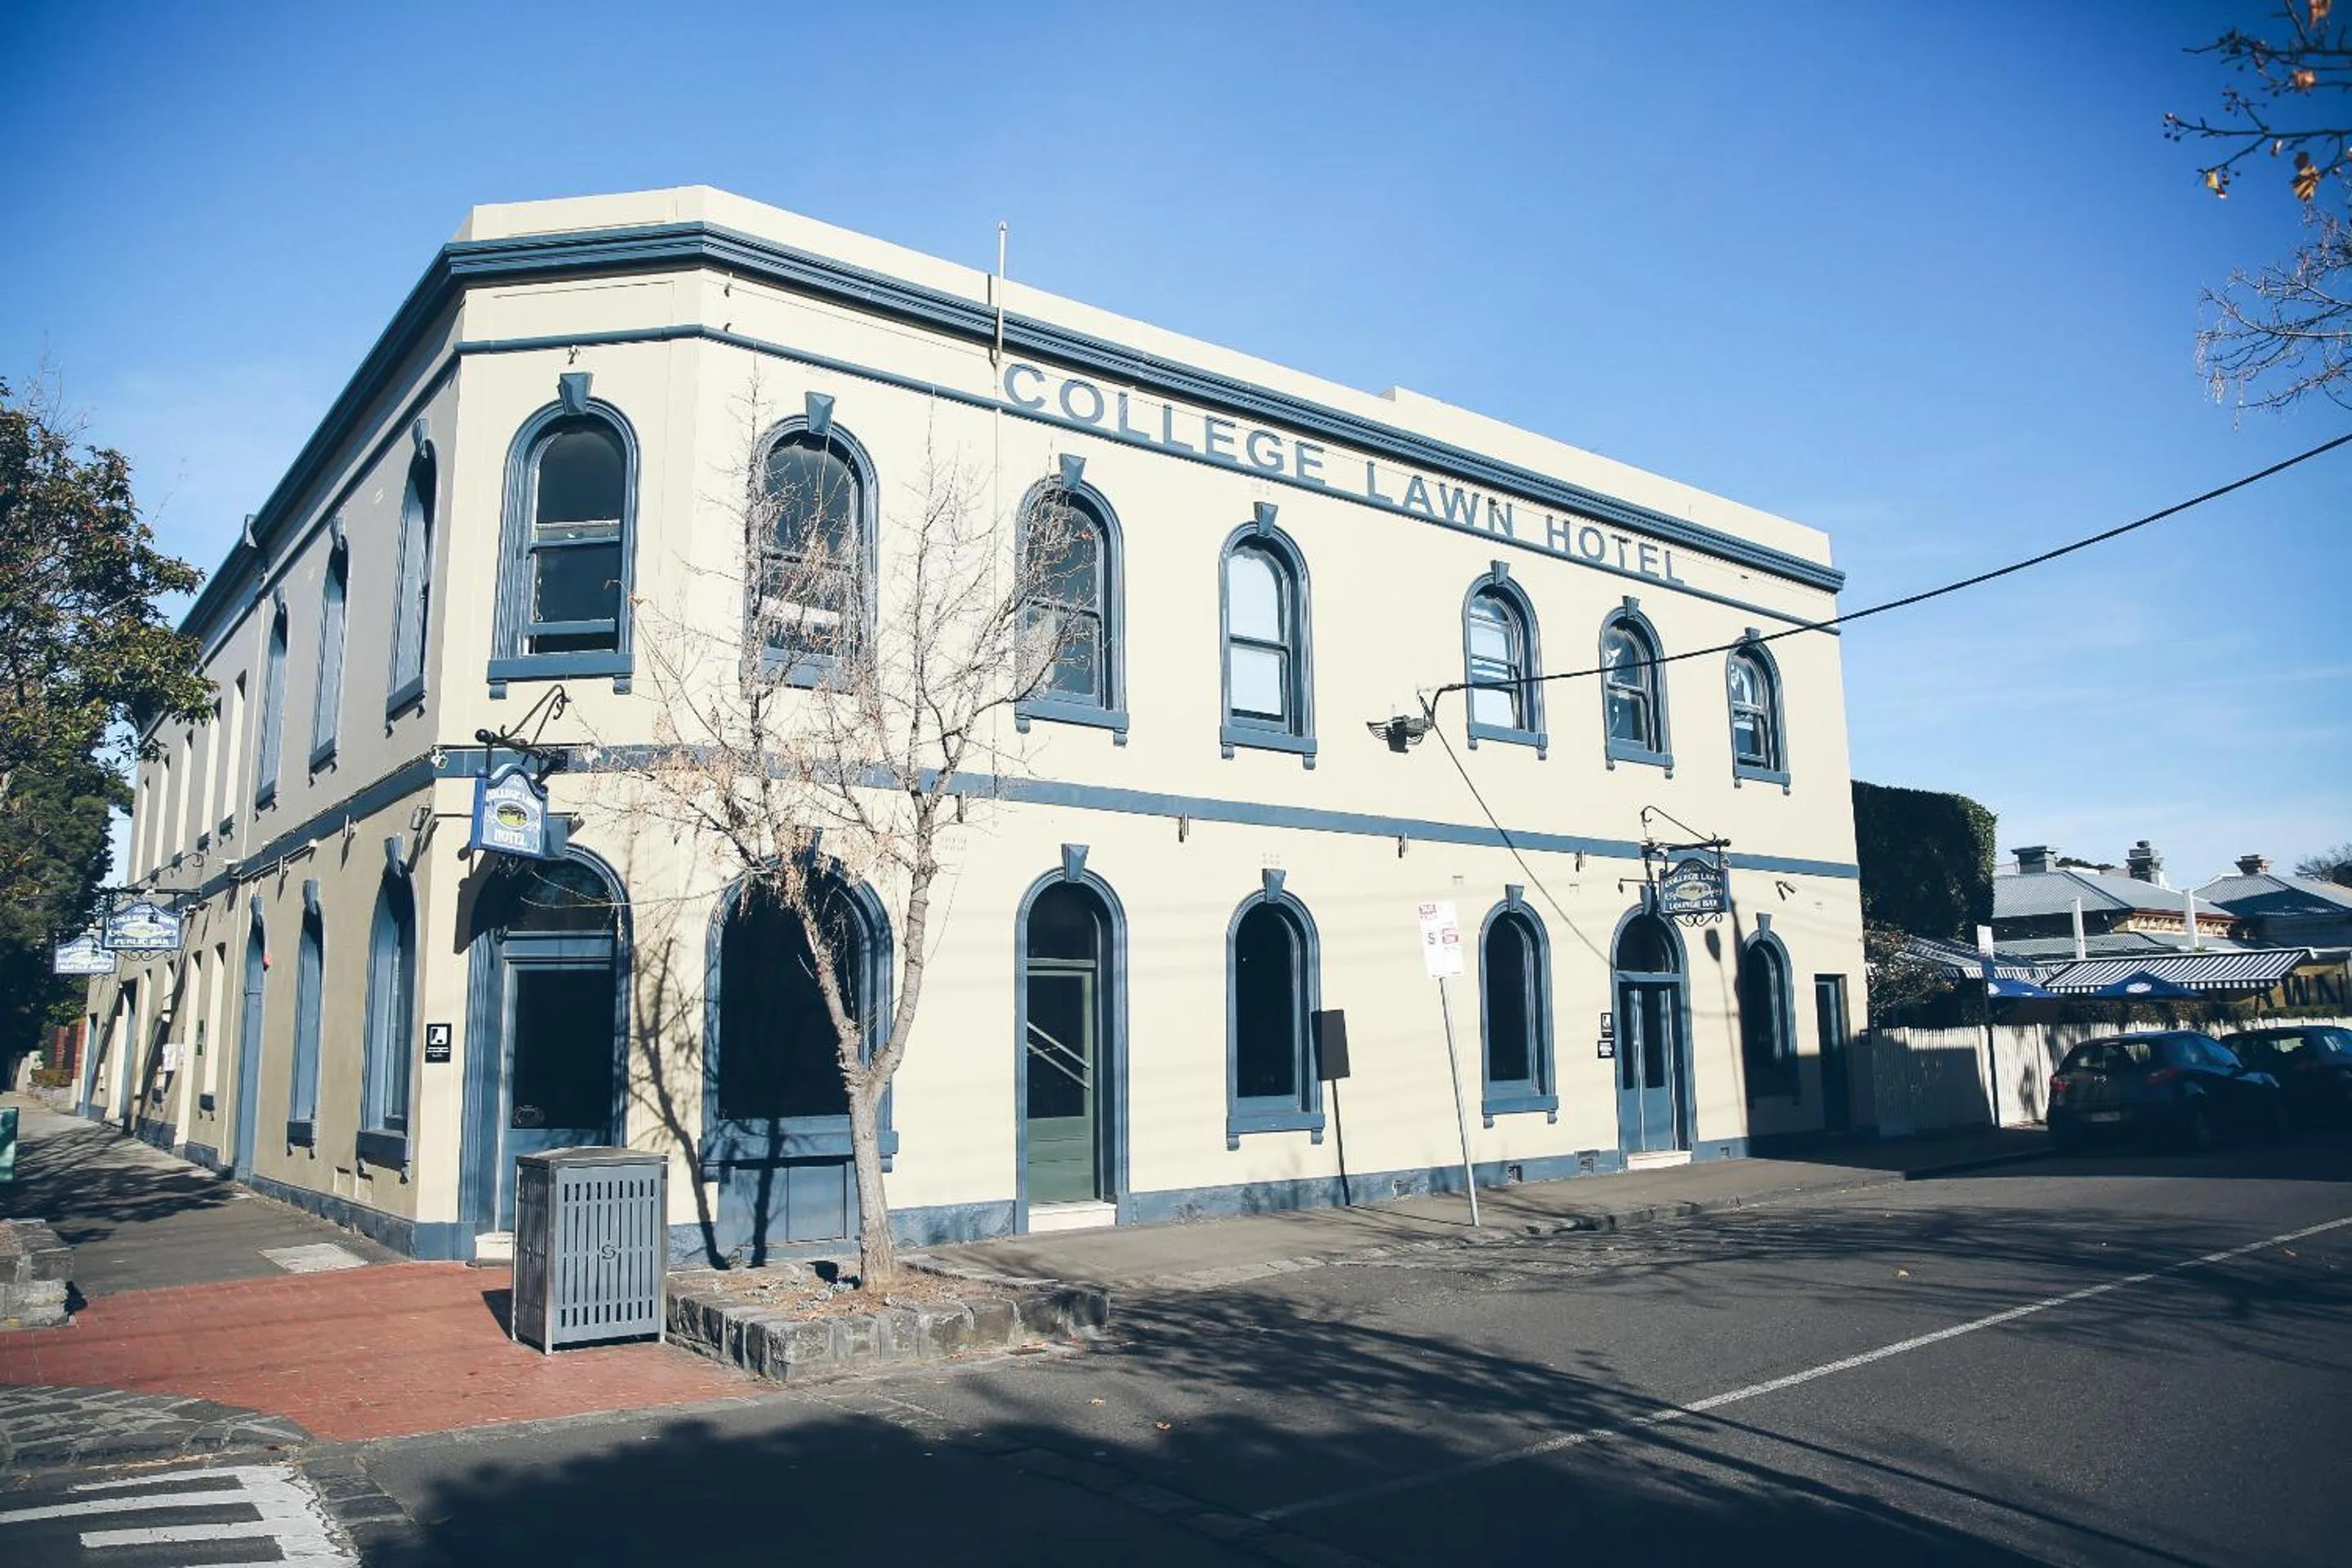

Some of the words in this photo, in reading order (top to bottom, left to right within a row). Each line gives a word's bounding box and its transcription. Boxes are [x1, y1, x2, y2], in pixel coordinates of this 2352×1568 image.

[1003, 363, 1325, 486] COLLEGE
[1366, 461, 1514, 539] LAWN
[1546, 514, 1685, 586] HOTEL
